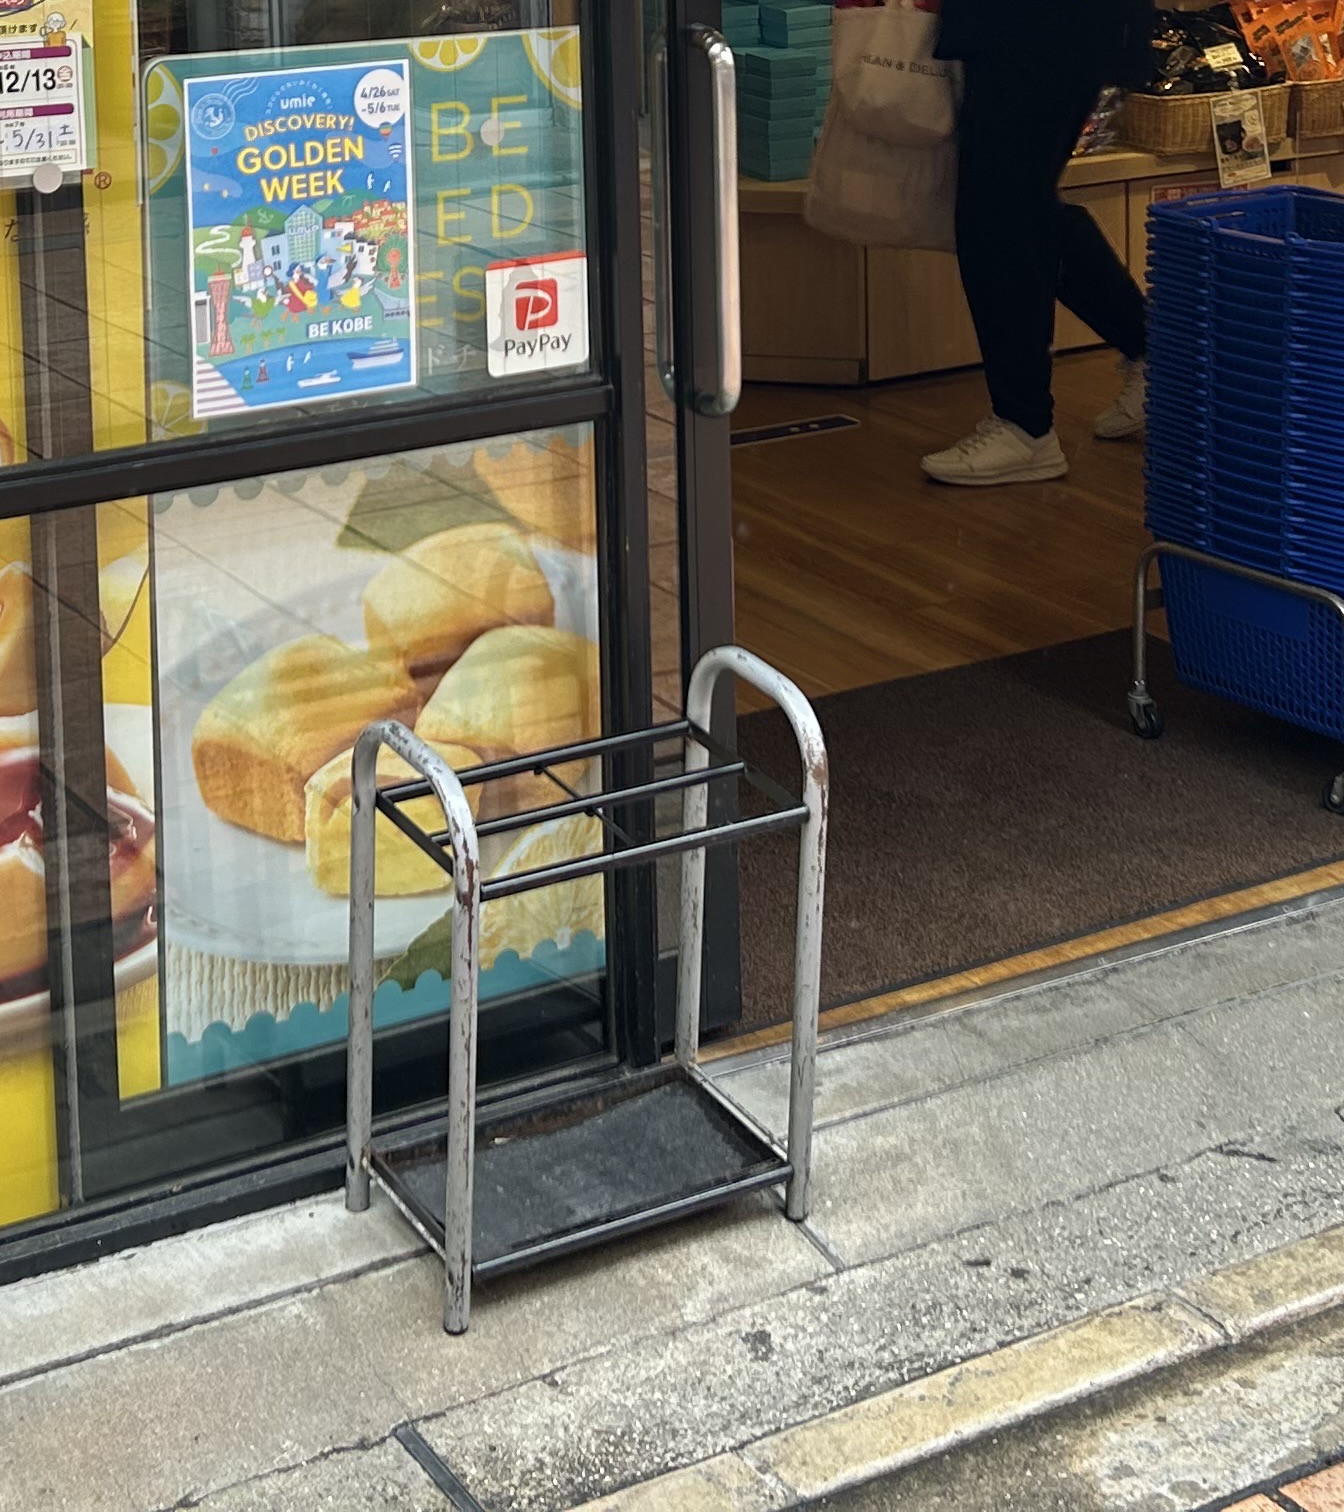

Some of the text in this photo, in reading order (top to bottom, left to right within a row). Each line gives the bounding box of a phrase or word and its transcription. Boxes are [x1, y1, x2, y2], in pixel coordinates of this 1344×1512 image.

[280, 93, 316, 110] umie
[360, 85, 386, 100] 4/26
[12, 128, 53, 151] 5/31
[244, 113, 355, 142] DISCOVERY!
[236, 135, 365, 175] GOLDEN
[260, 168, 345, 204] WEEK
[308, 315, 374, 339] BE KOBE
[504, 332, 573, 359] PayPay
